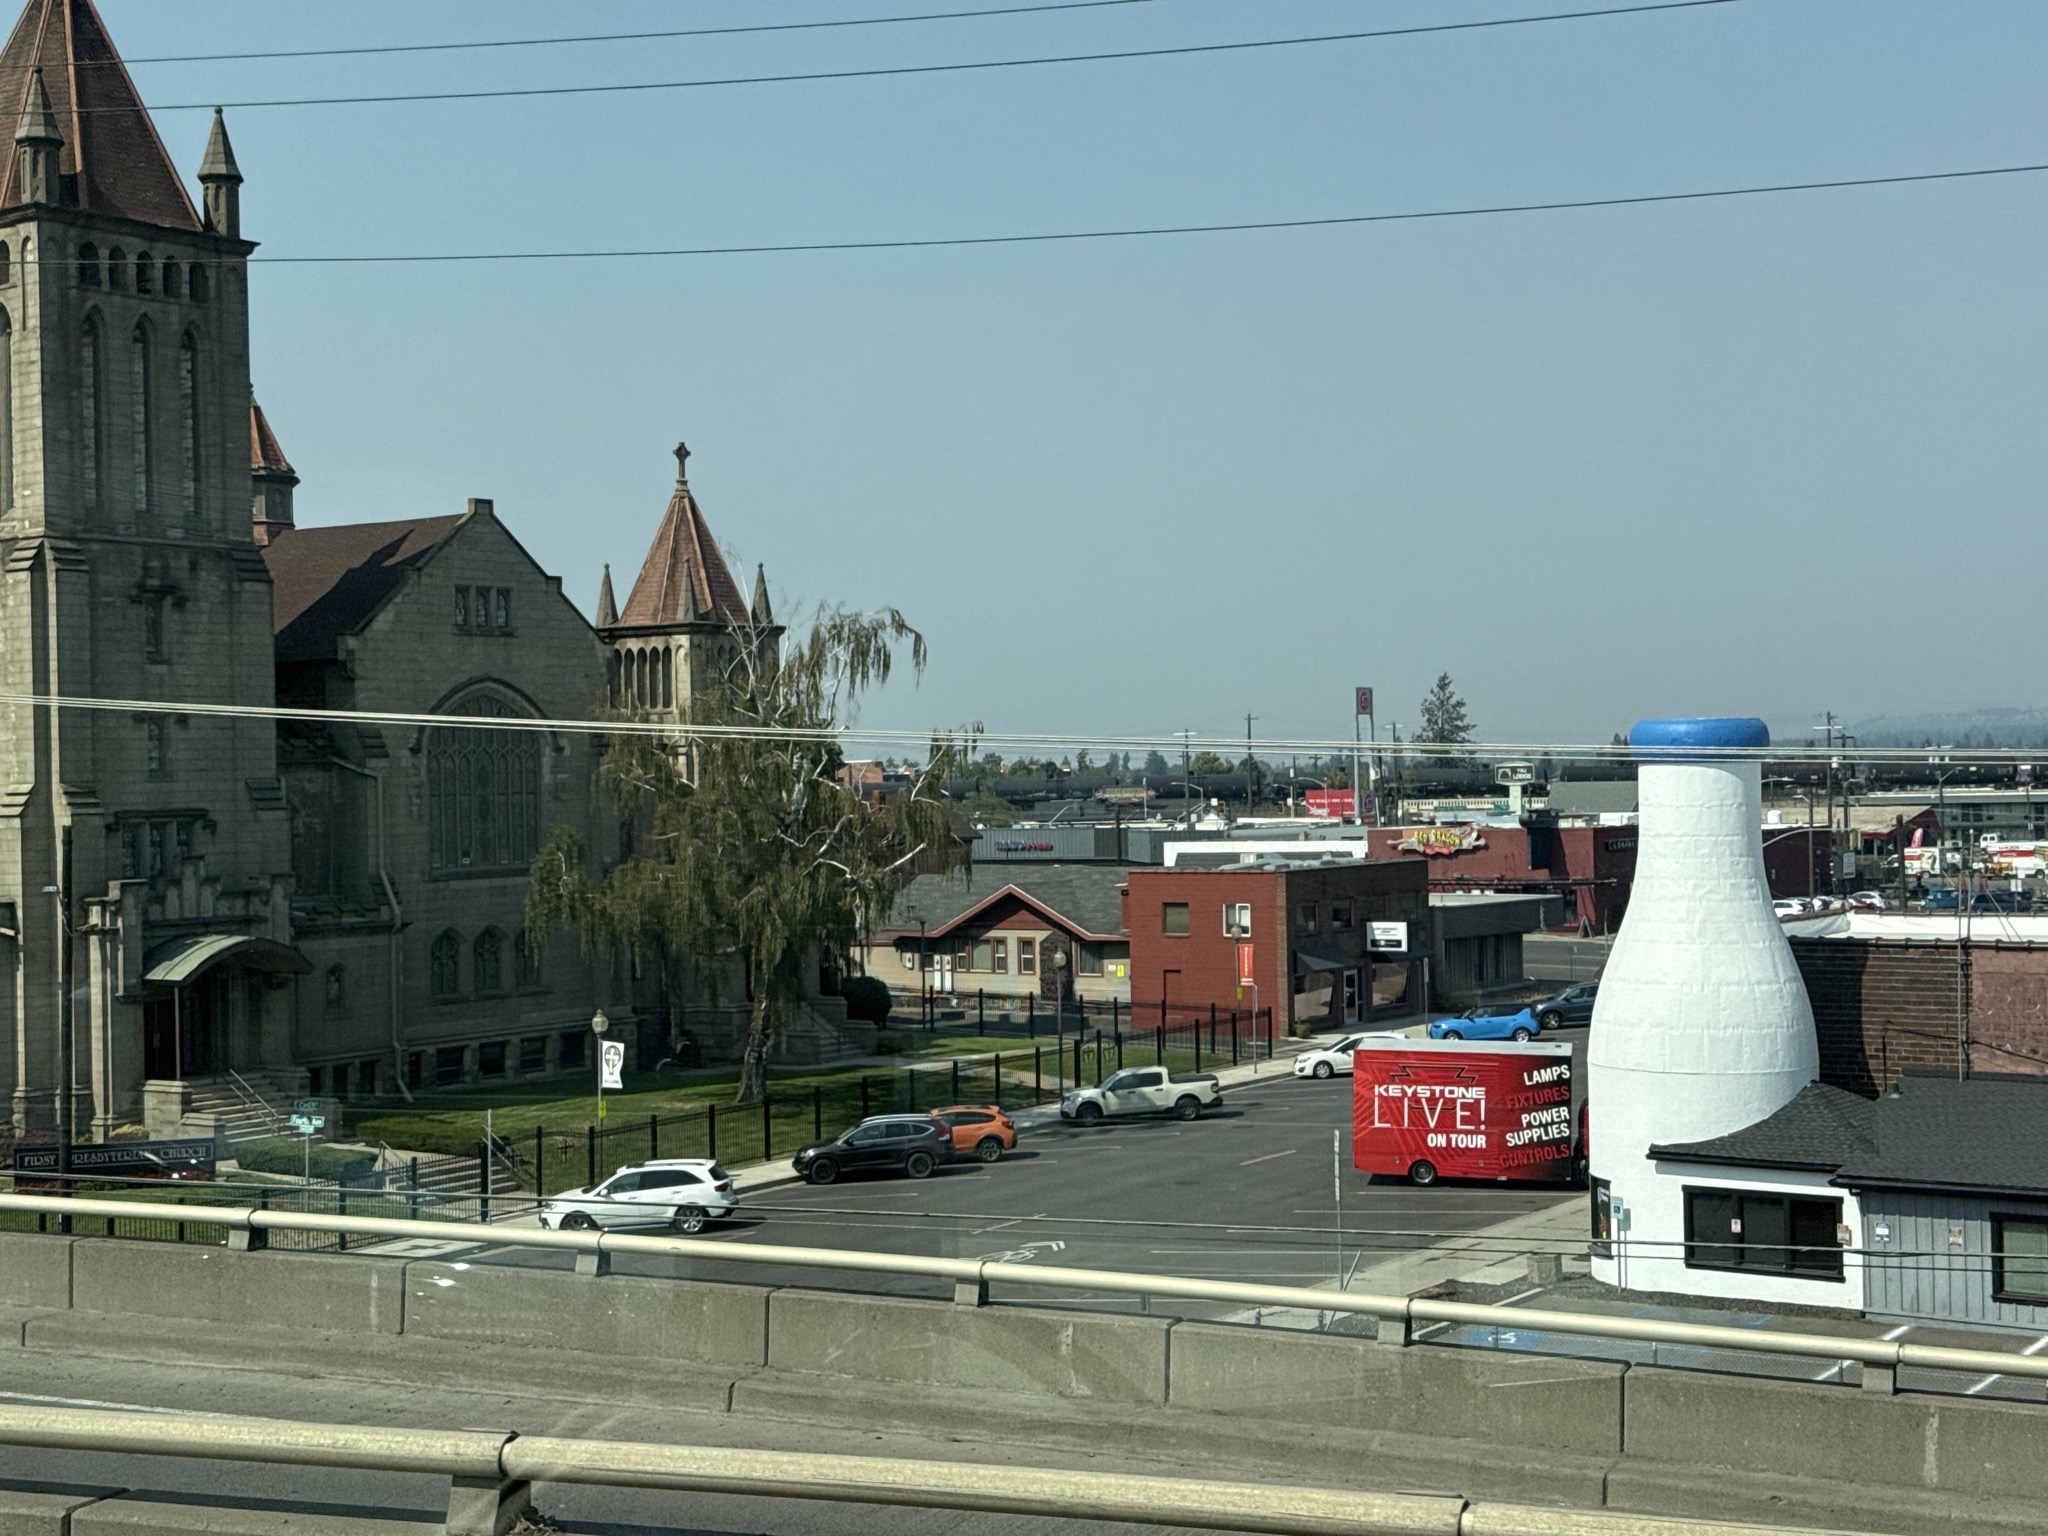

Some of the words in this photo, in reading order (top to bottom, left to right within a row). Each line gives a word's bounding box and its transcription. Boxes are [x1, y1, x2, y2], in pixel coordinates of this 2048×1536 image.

[1414, 830, 1428, 844] RED
[1431, 829, 1460, 846] DRAGON
[1523, 1065, 1571, 1086] LAMPS
[1374, 1084, 1486, 1099] KEYSTONE
[1506, 1086, 1570, 1109] FIXTURES
[1374, 1097, 1486, 1130] LIVE!
[1521, 1106, 1570, 1127] POWER
[1427, 1133, 1447, 1148] ON
[1449, 1134, 1486, 1149] TOUR
[1505, 1123, 1570, 1147] SUPPLIES
[24, 1154, 57, 1167] FIRST
[71, 1149, 152, 1165] RESBYTERIAN
[161, 1146, 207, 1159] CHURCH
[1500, 1144, 1570, 1168] CONTROLS
